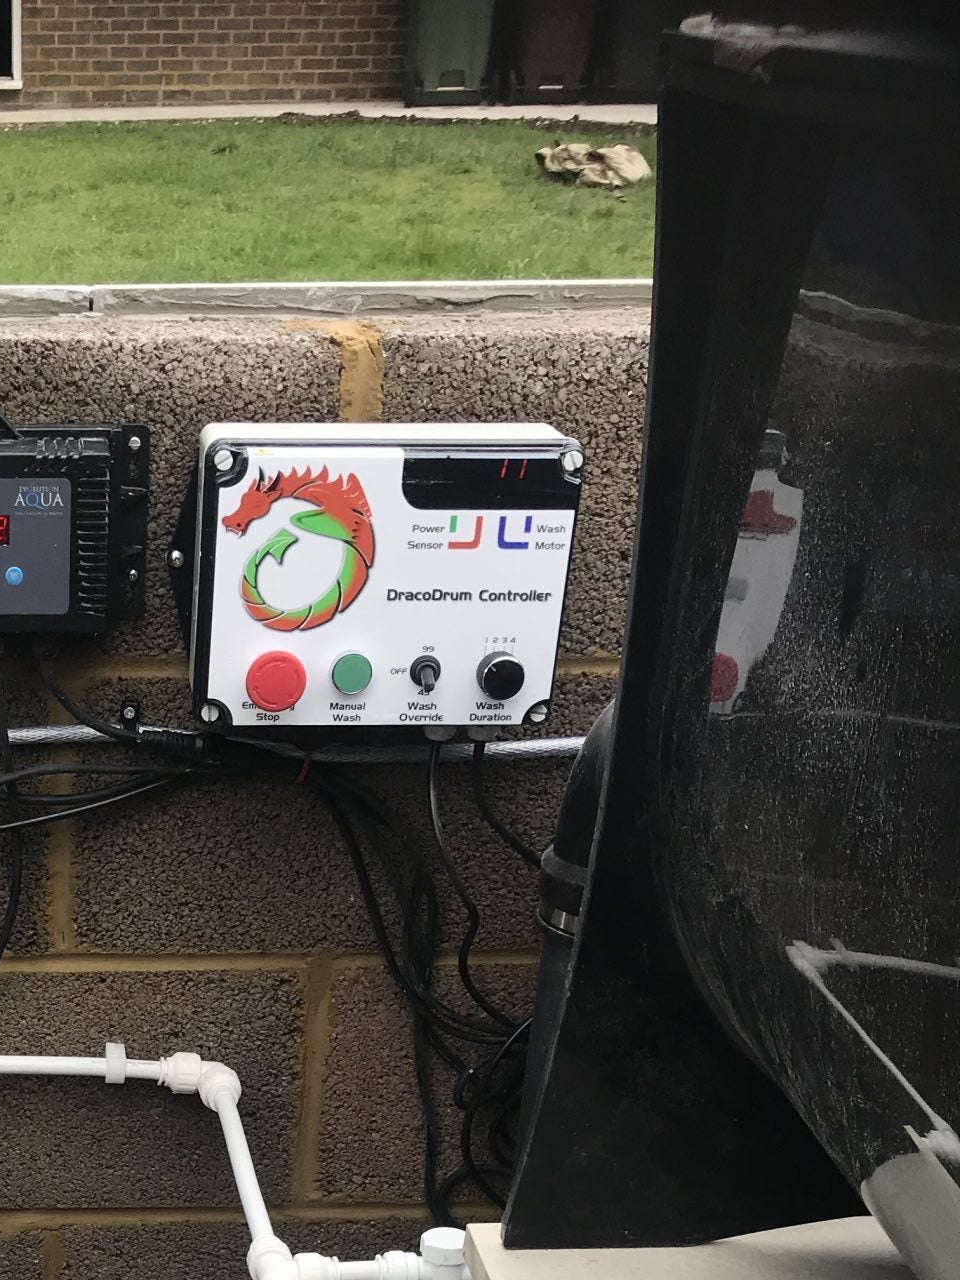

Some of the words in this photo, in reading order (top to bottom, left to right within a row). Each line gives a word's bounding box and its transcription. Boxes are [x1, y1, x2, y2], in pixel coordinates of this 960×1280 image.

[14, 492, 64, 509] AQUA
[411, 524, 445, 533] Power
[536, 524, 566, 533] Wash
[407, 541, 444, 549] Sensor
[534, 541, 566, 550] Motor
[386, 588, 472, 601] DracoDrum
[478, 589, 552, 602] Controller
[422, 645, 435, 653] 99
[329, 702, 366, 711] Manual
[407, 702, 437, 711] Wash
[475, 702, 505, 710] Wash
[255, 712, 280, 722] Stop
[332, 713, 362, 722] Wash
[399, 713, 444, 722] Override
[469, 713, 512, 722] Duration
